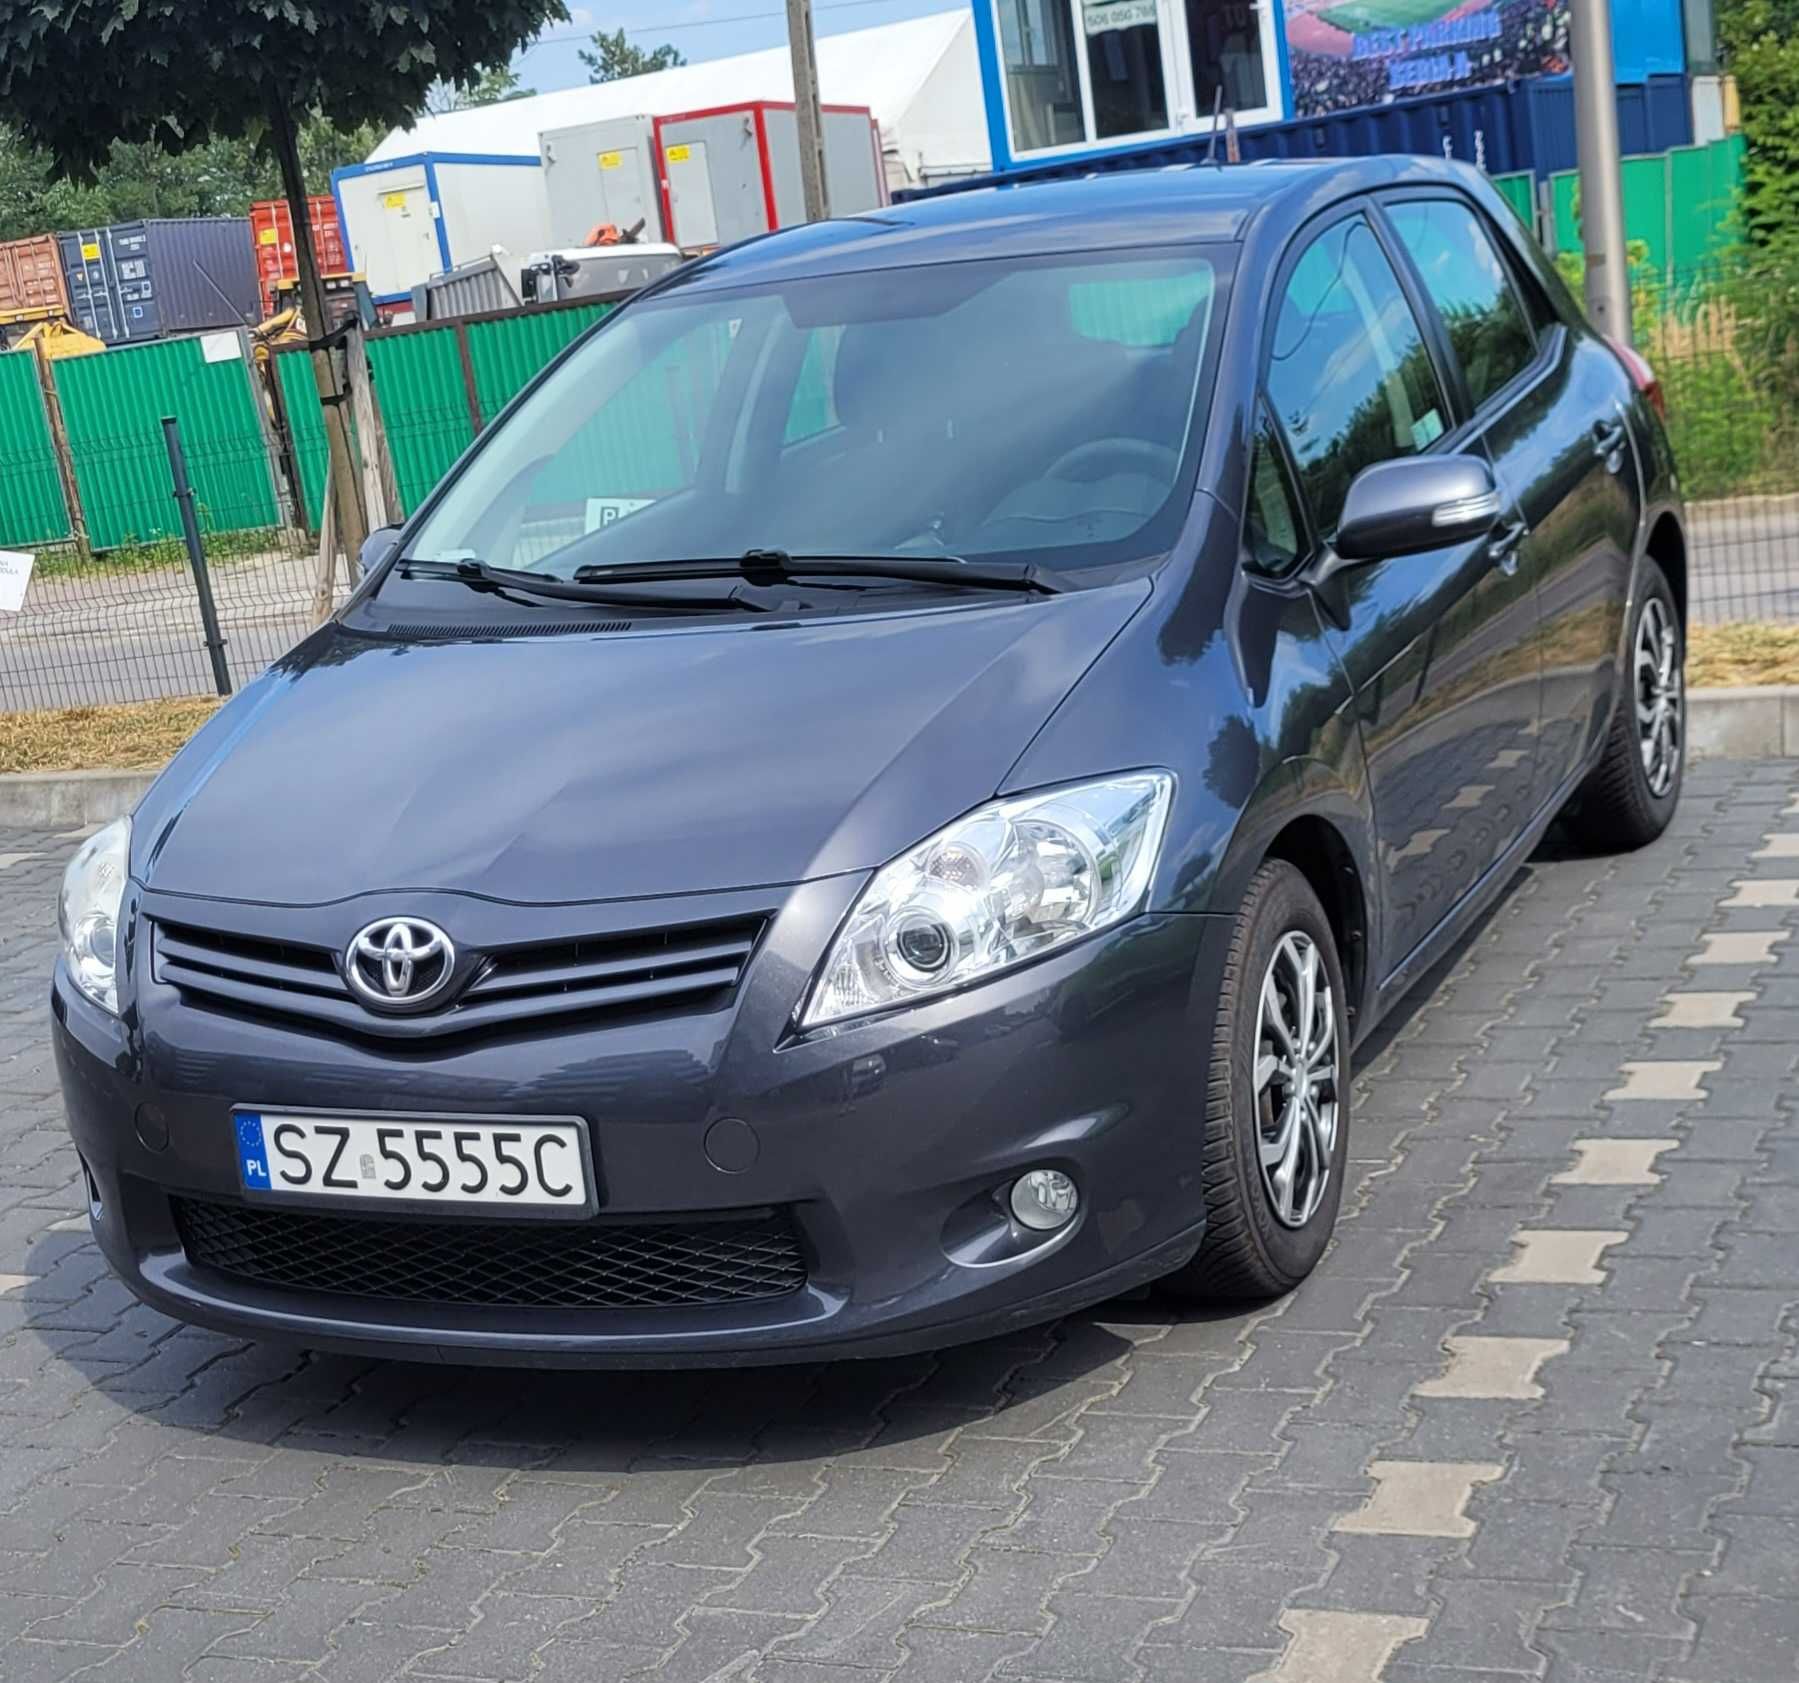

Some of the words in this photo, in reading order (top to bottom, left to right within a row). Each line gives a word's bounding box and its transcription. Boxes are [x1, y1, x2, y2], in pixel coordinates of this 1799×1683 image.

[246, 1159, 267, 1177] PL
[273, 1123, 359, 1189] SZ
[376, 1127, 573, 1197] 5555C
